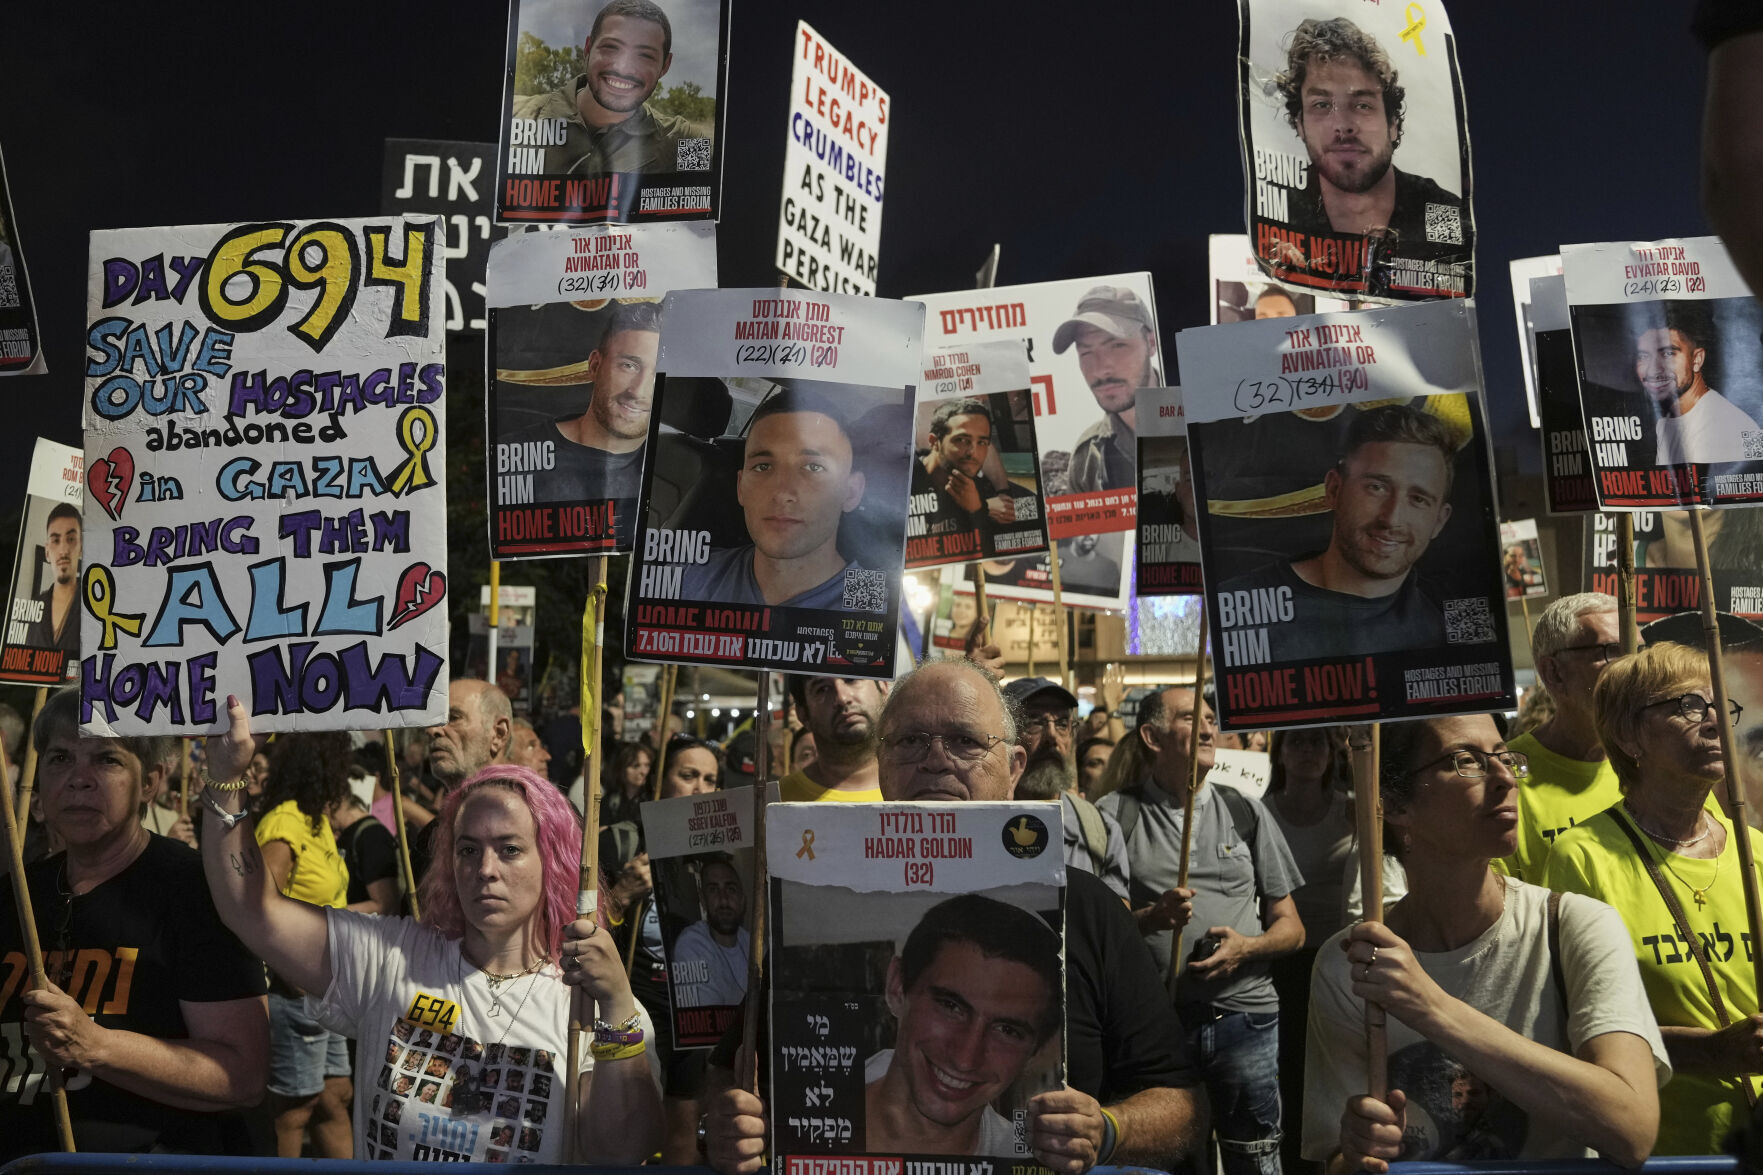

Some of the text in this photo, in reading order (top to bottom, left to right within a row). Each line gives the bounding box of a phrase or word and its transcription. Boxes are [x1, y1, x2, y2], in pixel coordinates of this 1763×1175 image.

[801, 28, 886, 126] TRUMP'S
[804, 76, 879, 157] LEGACY
[511, 118, 567, 146] BRING
[508, 148, 545, 175] HIM
[792, 111, 884, 203] CRUMBLES
[1255, 148, 1308, 190] BRING
[395, 154, 482, 202] את
[506, 173, 619, 207] HOME NOW!
[640, 195, 711, 211] FAMILIES FORUM
[641, 186, 711, 198] HOSTAGES AND MISSING
[801, 163, 868, 235] AS THE
[1257, 180, 1289, 224] HIM
[571, 236, 592, 254] אור
[784, 196, 878, 285] GAZA WAR
[1257, 222, 1306, 269] HOME
[565, 252, 640, 274] AVINATAN OR
[1625, 261, 1701, 280] EVYATAR DAVID
[102, 254, 203, 307] DAY
[200, 220, 432, 354] 694
[1390, 270, 1464, 293] FAMILIES FORUM
[805, 301, 831, 322] מתן
[940, 302, 1027, 334] מחזירים
[3, 328, 29, 341] MISSING
[735, 321, 845, 345] MATAN ANGREST
[1285, 323, 1363, 349] אבינתן אור
[2, 341, 31, 358] FORUM
[87, 316, 236, 379] SAVE
[1281, 345, 1377, 375] AVINATAN OR
[924, 363, 982, 382] NIMROD COHEN
[91, 362, 445, 421] OUR HOSTAGES
[935, 381, 957, 396] (20)
[1159, 406, 1176, 417] BAR
[146, 414, 348, 452] abandoned
[1591, 416, 1643, 441] BRING
[1551, 430, 1588, 453] BRIN
[497, 440, 556, 473] BRING
[1553, 453, 1582, 477] HIM
[1595, 442, 1628, 467] HIM
[62, 467, 79, 482] ROM
[135, 455, 390, 503] in GAZA
[1601, 470, 1648, 496] HOME
[1714, 473, 1743, 484] HOSTAGES
[1744, 472, 1754, 482] AND
[497, 474, 535, 505] HIM
[1716, 481, 1753, 496] FAMILIES
[909, 492, 939, 516] RING
[499, 500, 616, 541] HOME NOW!
[111, 509, 412, 568] BRING THEM
[643, 527, 713, 565] BRING
[942, 528, 982, 555] NOW!
[1142, 524, 1181, 543] BRING
[1142, 544, 1167, 563] HIM
[639, 565, 684, 600] HIM
[1731, 586, 1760, 600] HOSTAGES
[12, 599, 45, 623] BRING
[141, 556, 385, 648] ALL
[1217, 586, 1295, 628] BRING
[1731, 598, 1763, 614] FAMILIE
[7, 622, 29, 645] HIM
[842, 618, 884, 632] אתם לא לבד
[682, 632, 717, 656] טבח
[717, 636, 743, 658] את
[746, 638, 800, 660] שכחנו
[803, 641, 826, 665] לא
[1222, 627, 1271, 667] HIM
[2, 647, 33, 672] HOME
[35, 649, 64, 675] NOW!
[1404, 662, 1500, 682] HOSTAGES AND MISSING
[79, 641, 445, 725] HOME NOW
[1227, 657, 1378, 710] HOME NOW!
[1406, 674, 1502, 700] FAMILIES FORUM
[879, 811, 956, 835] הדר גולדין
[864, 837, 973, 860] HADAR GOLDIN
[904, 862, 934, 887] (32)
[671, 959, 710, 985] BRING
[675, 984, 700, 1009] HIM
[407, 994, 457, 1029] 694
[677, 1011, 714, 1035] HOME
